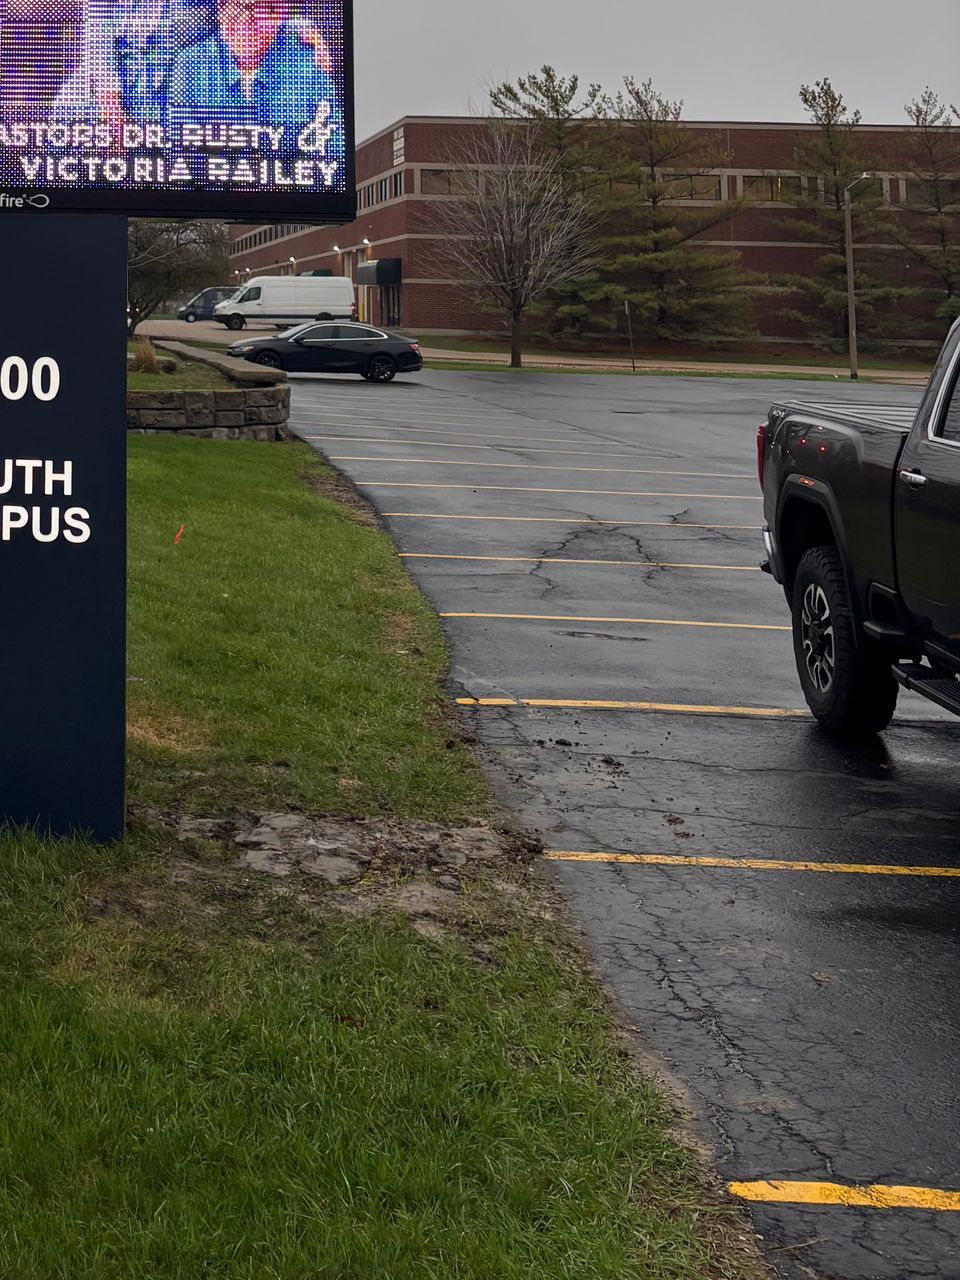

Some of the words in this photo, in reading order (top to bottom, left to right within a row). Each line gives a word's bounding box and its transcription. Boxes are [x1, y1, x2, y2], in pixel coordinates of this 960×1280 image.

[181, 124, 286, 151] RUSTY
[296, 100, 337, 156] &
[20, 155, 193, 183] VICTORIA
